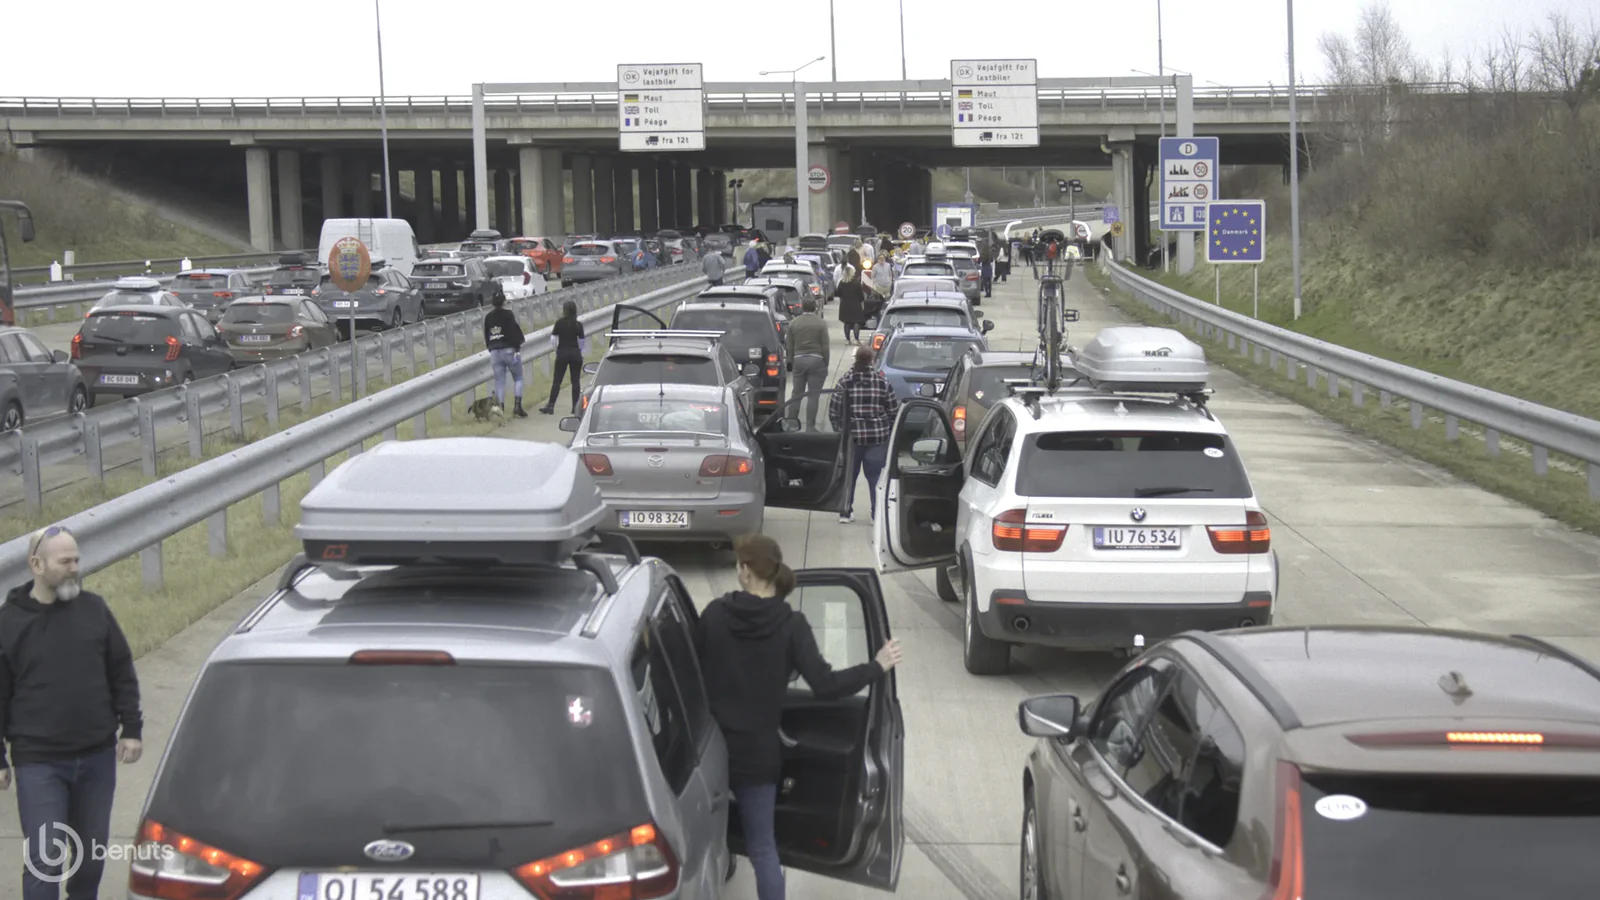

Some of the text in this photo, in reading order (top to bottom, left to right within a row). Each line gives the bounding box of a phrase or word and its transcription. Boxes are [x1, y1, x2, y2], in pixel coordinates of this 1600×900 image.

[643, 68, 679, 76] Vejafgift
[977, 64, 1012, 72] Vejafgift
[977, 90, 997, 98] Maut
[644, 106, 660, 114] Toll
[978, 102, 994, 110] Toll
[677, 136, 689, 144] 12t
[996, 132, 1024, 140] fra 12t
[1185, 144, 1193, 154] D
[1196, 165, 1206, 174] 50
[902, 226, 913, 234] 20
[648, 512, 663, 524] 98
[665, 512, 685, 524] 324
[1109, 529, 1177, 544] IU 76 534
[370, 878, 404, 900] 54
[415, 878, 468, 900] 588
